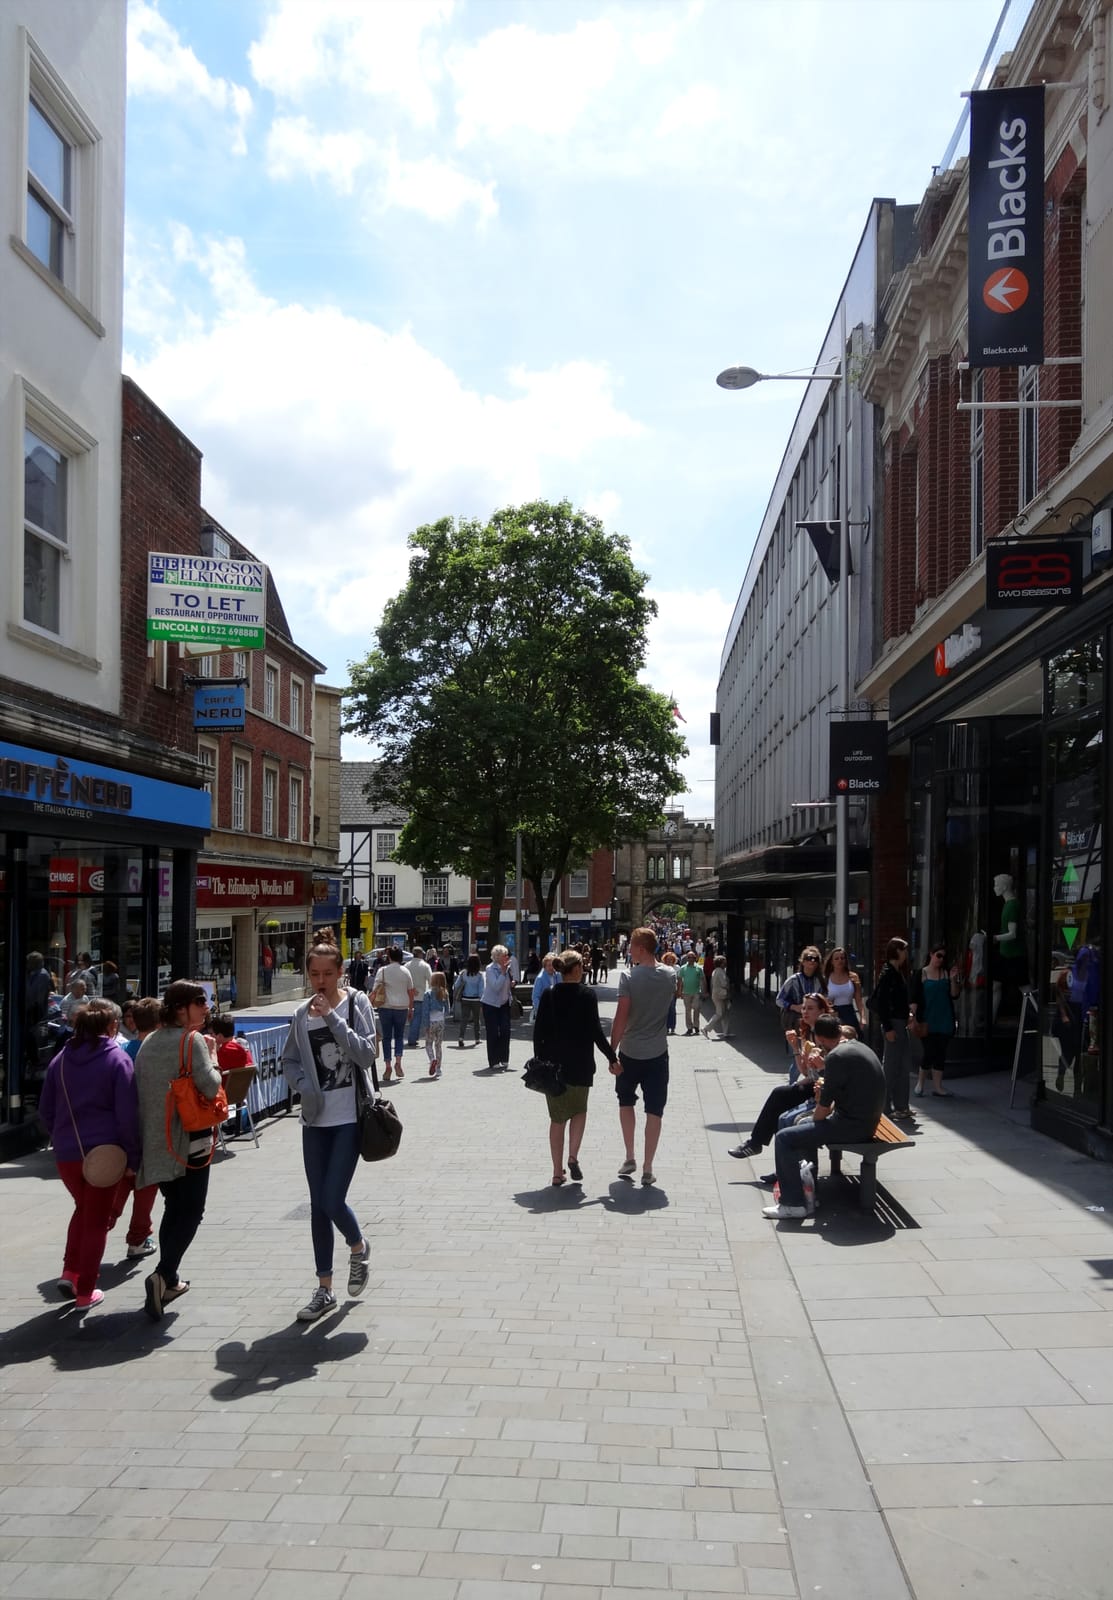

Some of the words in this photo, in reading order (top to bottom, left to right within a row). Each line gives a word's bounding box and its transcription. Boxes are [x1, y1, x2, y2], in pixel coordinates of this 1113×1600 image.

[988, 117, 1027, 261] Blacks
[983, 345, 1028, 355] Blacks.co.uk
[181, 558, 262, 575] HODGSON
[181, 570, 262, 587] ELKINGTON
[170, 593, 200, 608] TO
[207, 596, 245, 612] LET
[155, 607, 205, 620] RESTAURANT
[207, 611, 259, 623] OPPORTUNITY
[152, 621, 199, 633] LINCOLN
[201, 626, 226, 635] 01522
[196, 707, 242, 719] NERO
[71, 772, 132, 810] NERO
[849, 779, 880, 789] Blacks
[212, 877, 226, 894] The
[228, 878, 260, 900] Edinburgh
[261, 879, 283, 896] Woollen
[283, 880, 294, 896] Mill
